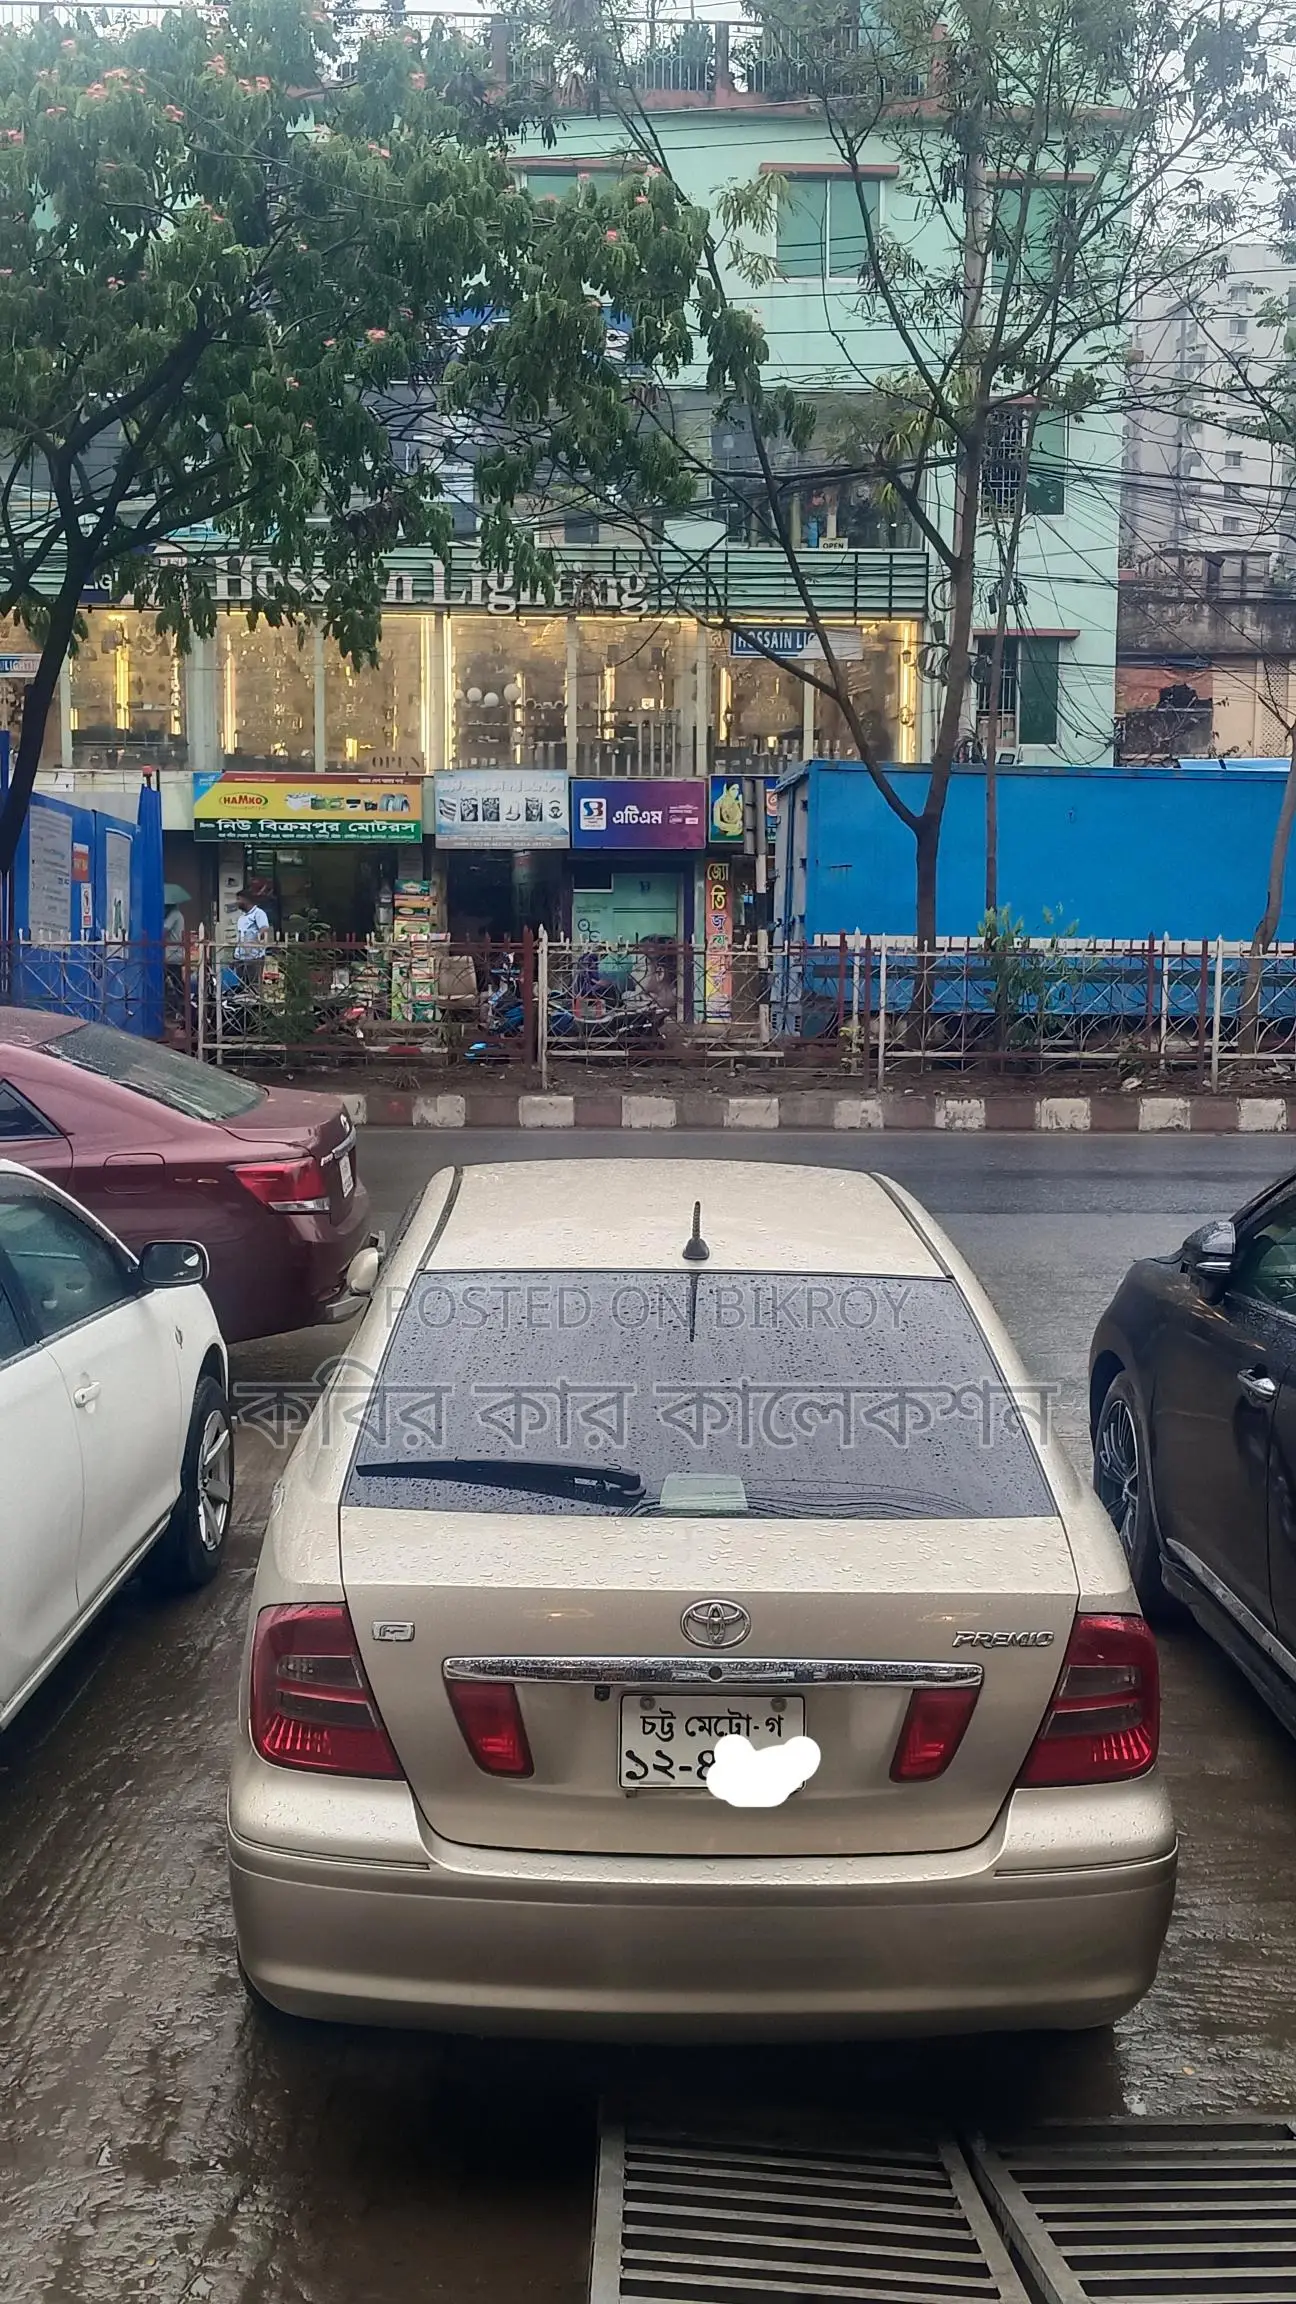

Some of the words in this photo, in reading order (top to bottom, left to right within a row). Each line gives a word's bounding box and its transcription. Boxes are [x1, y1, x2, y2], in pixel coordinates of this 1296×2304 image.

[822, 542, 845, 550] OPEN
[208, 556, 415, 605] Hossn
[371, 755, 421, 769] OPEN
[223, 793, 263, 806] HAMKO
[612, 805, 663, 825] এটিএম
[217, 819, 252, 833] নিউ
[258, 819, 341, 838] বিক্রমপুর
[348, 819, 416, 833] মোটরস
[952, 1631, 1054, 1649] PREMIO
[639, 1708, 677, 1742] চট্ট
